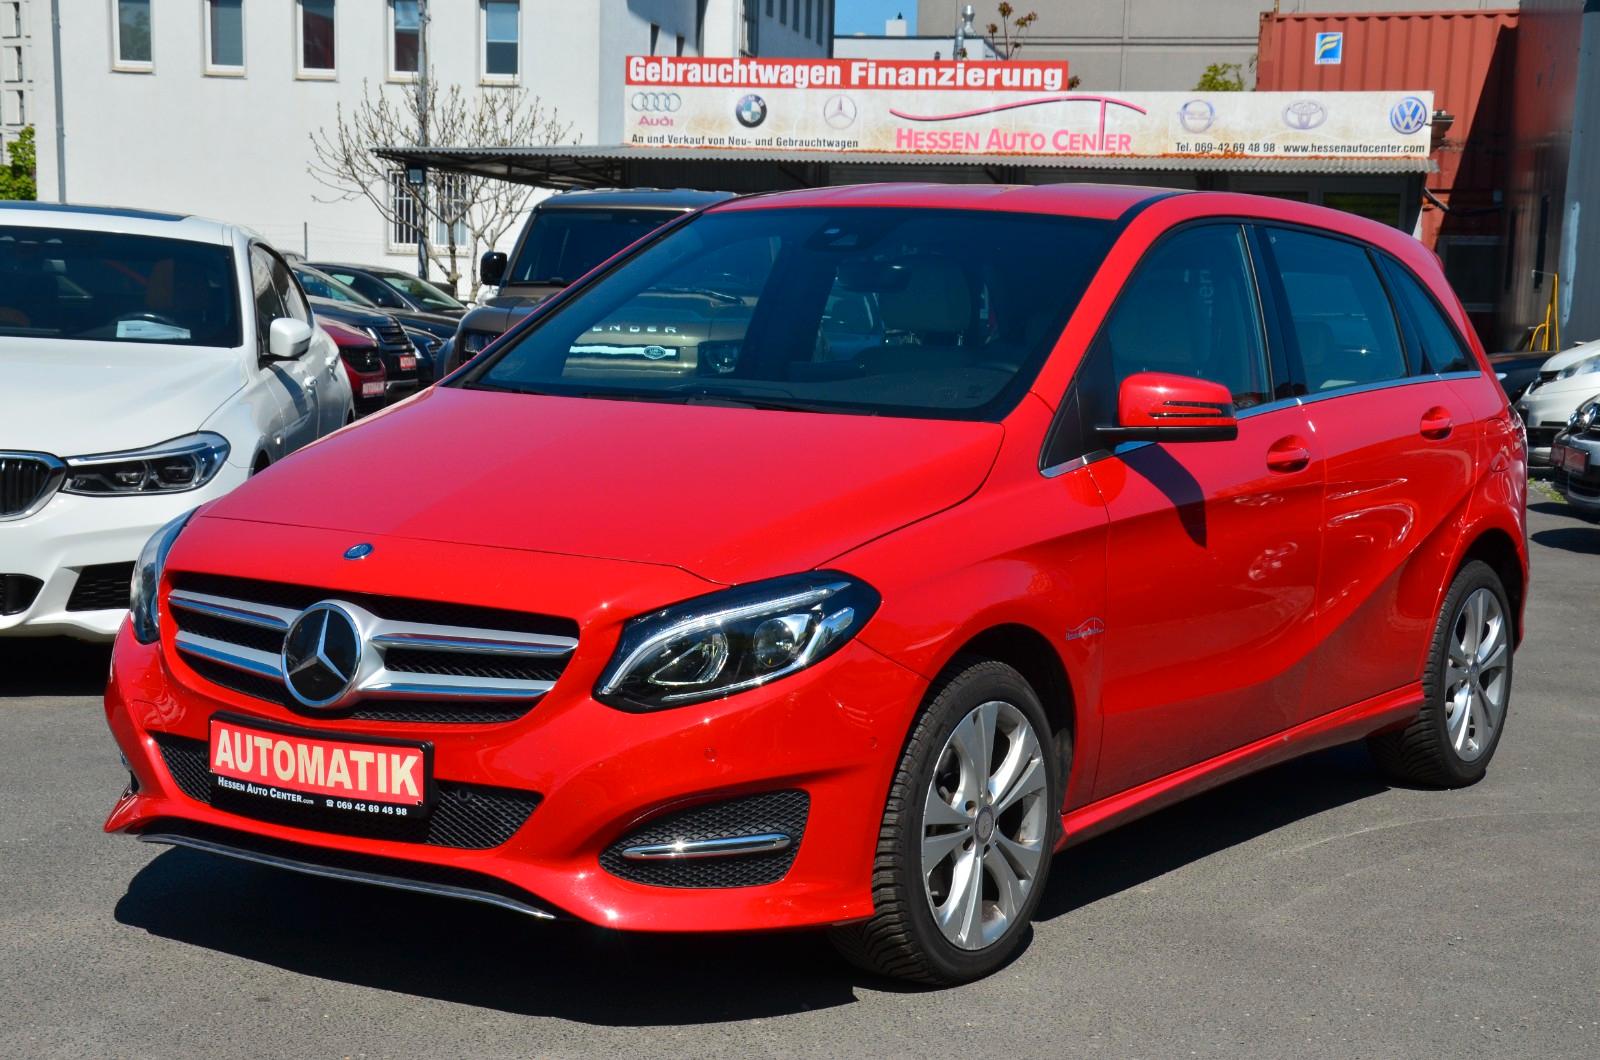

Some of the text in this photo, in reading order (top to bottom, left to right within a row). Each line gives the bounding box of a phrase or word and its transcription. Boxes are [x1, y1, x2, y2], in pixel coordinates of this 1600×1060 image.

[630, 56, 1063, 91] Gebrauchtwagen Finanzierung
[638, 115, 674, 126] Audi
[632, 134, 859, 149] An und Verkauf von Neu- und Gebrauchtwagen
[896, 128, 980, 149] HESSEN
[986, 128, 1046, 151] AUTO
[1176, 142, 1192, 152] Tel.
[1232, 143, 1245, 153] 69
[1248, 143, 1260, 152] 48
[1263, 143, 1275, 152] 98
[1283, 143, 1425, 153] www.hessenautocenter.com
[591, 325, 677, 333] ENDER
[215, 729, 420, 797] AUTOMATIK
[218, 776, 245, 791] HESSEN
[247, 783, 268, 796] AUTO
[336, 800, 407, 816] 069 42 69 48 98
